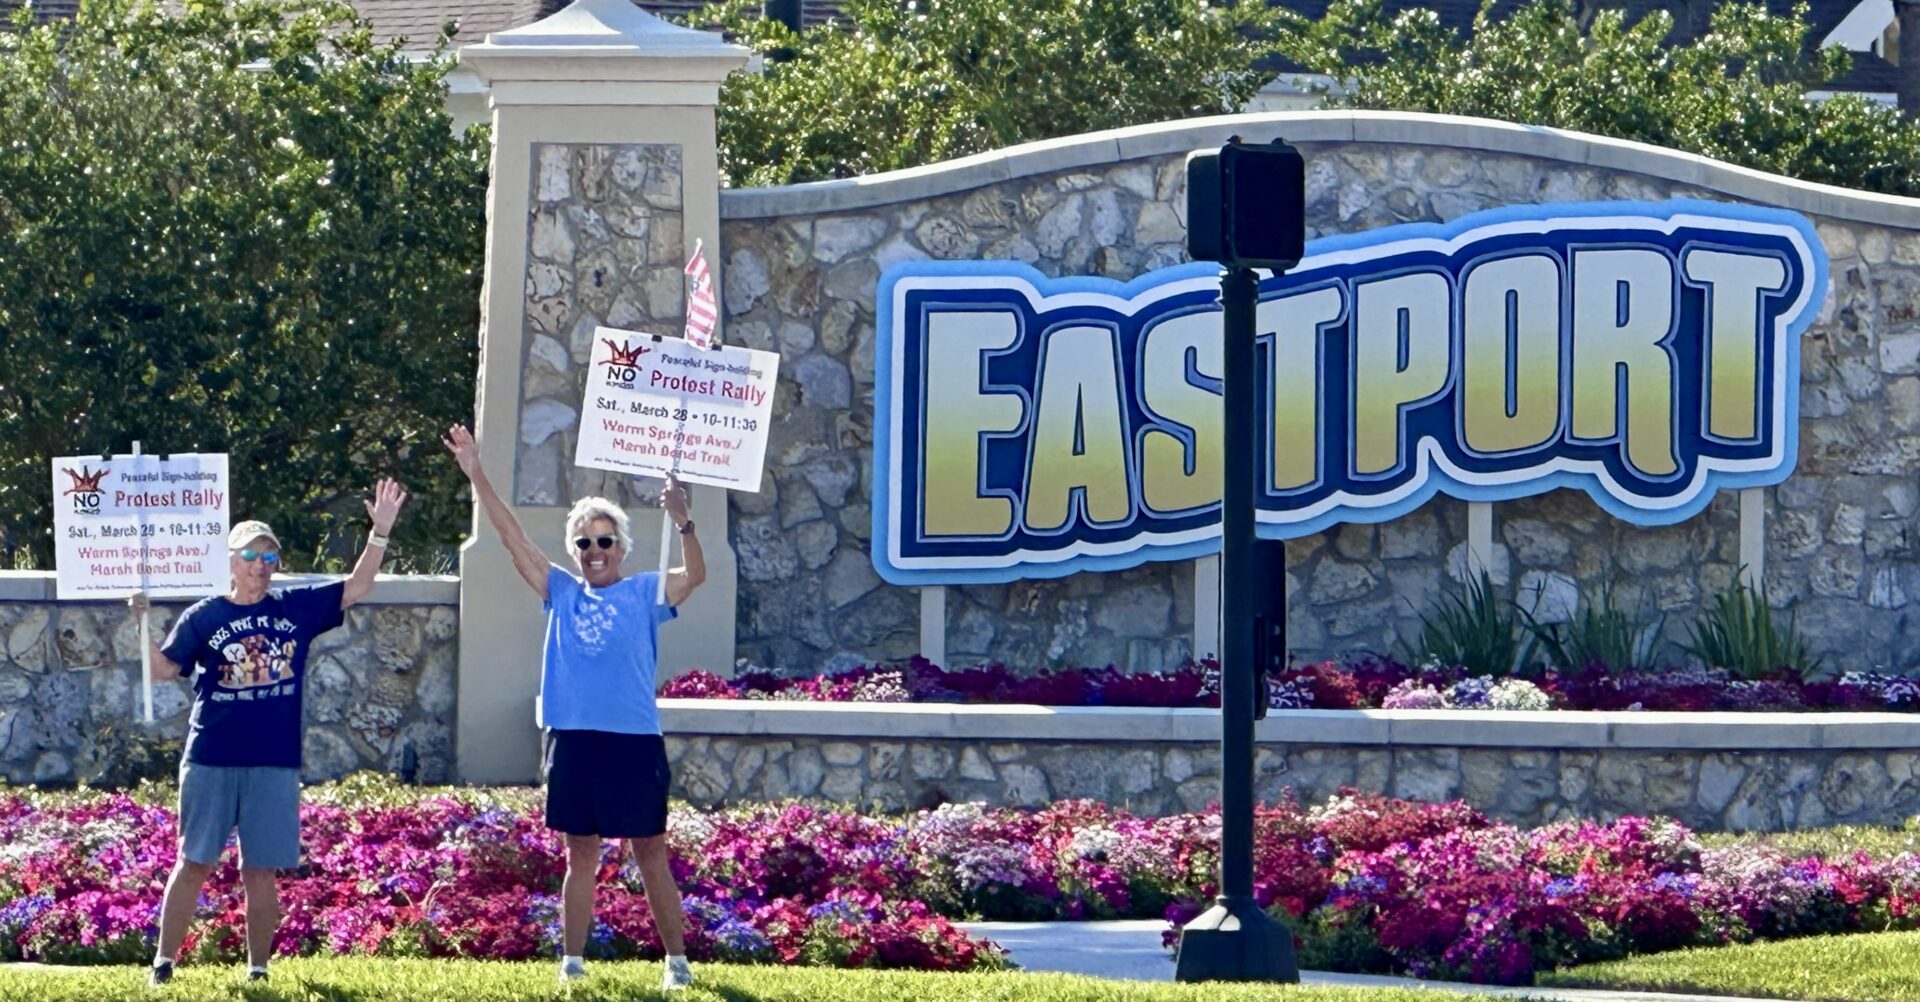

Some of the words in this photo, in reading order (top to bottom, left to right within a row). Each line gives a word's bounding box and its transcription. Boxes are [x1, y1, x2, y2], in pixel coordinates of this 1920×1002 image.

[607, 366, 636, 382] NO
[650, 370, 715, 395] Protest
[722, 380, 766, 406] Rally
[920, 242, 1789, 540] EASTPORT
[630, 402, 668, 418] March
[703, 413, 757, 431] 10-11:30
[649, 425, 702, 445] Springs
[612, 438, 656, 455] Marsh
[701, 450, 730, 466] Trail
[74, 493, 100, 508] NO
[114, 491, 176, 507] Protest
[182, 489, 223, 510] Rally
[101, 525, 138, 537] March
[78, 547, 119, 559] Warm
[122, 547, 173, 562] Springs
[90, 564, 133, 576] Marsh
[174, 562, 203, 574] Trail
